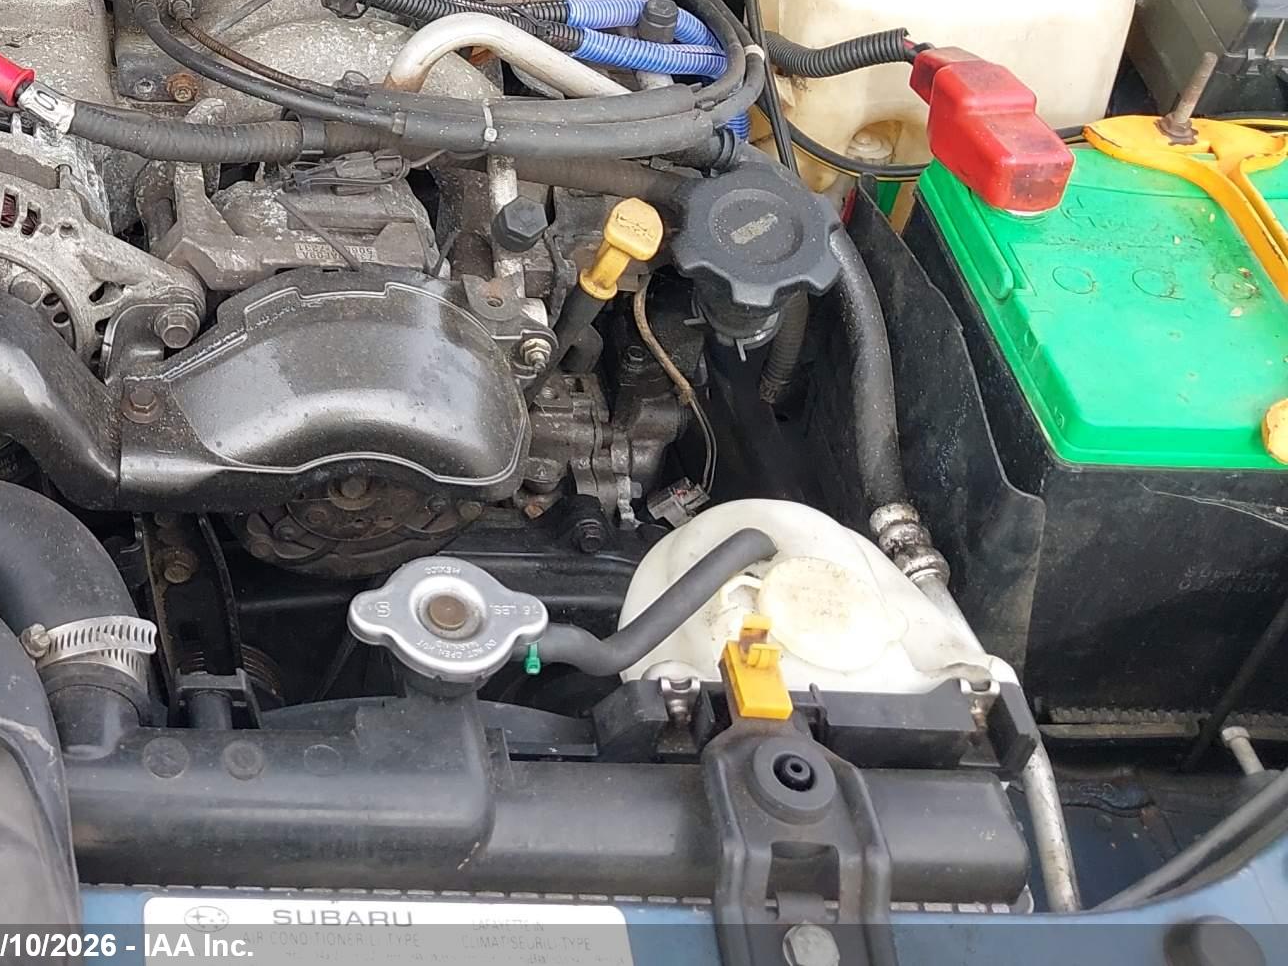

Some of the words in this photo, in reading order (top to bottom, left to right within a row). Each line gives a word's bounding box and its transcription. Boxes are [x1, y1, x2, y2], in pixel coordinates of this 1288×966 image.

[272, 910, 414, 928] SUBARU
[386, 934, 421, 949] TYPE
[560, 936, 592, 951] TYPE
